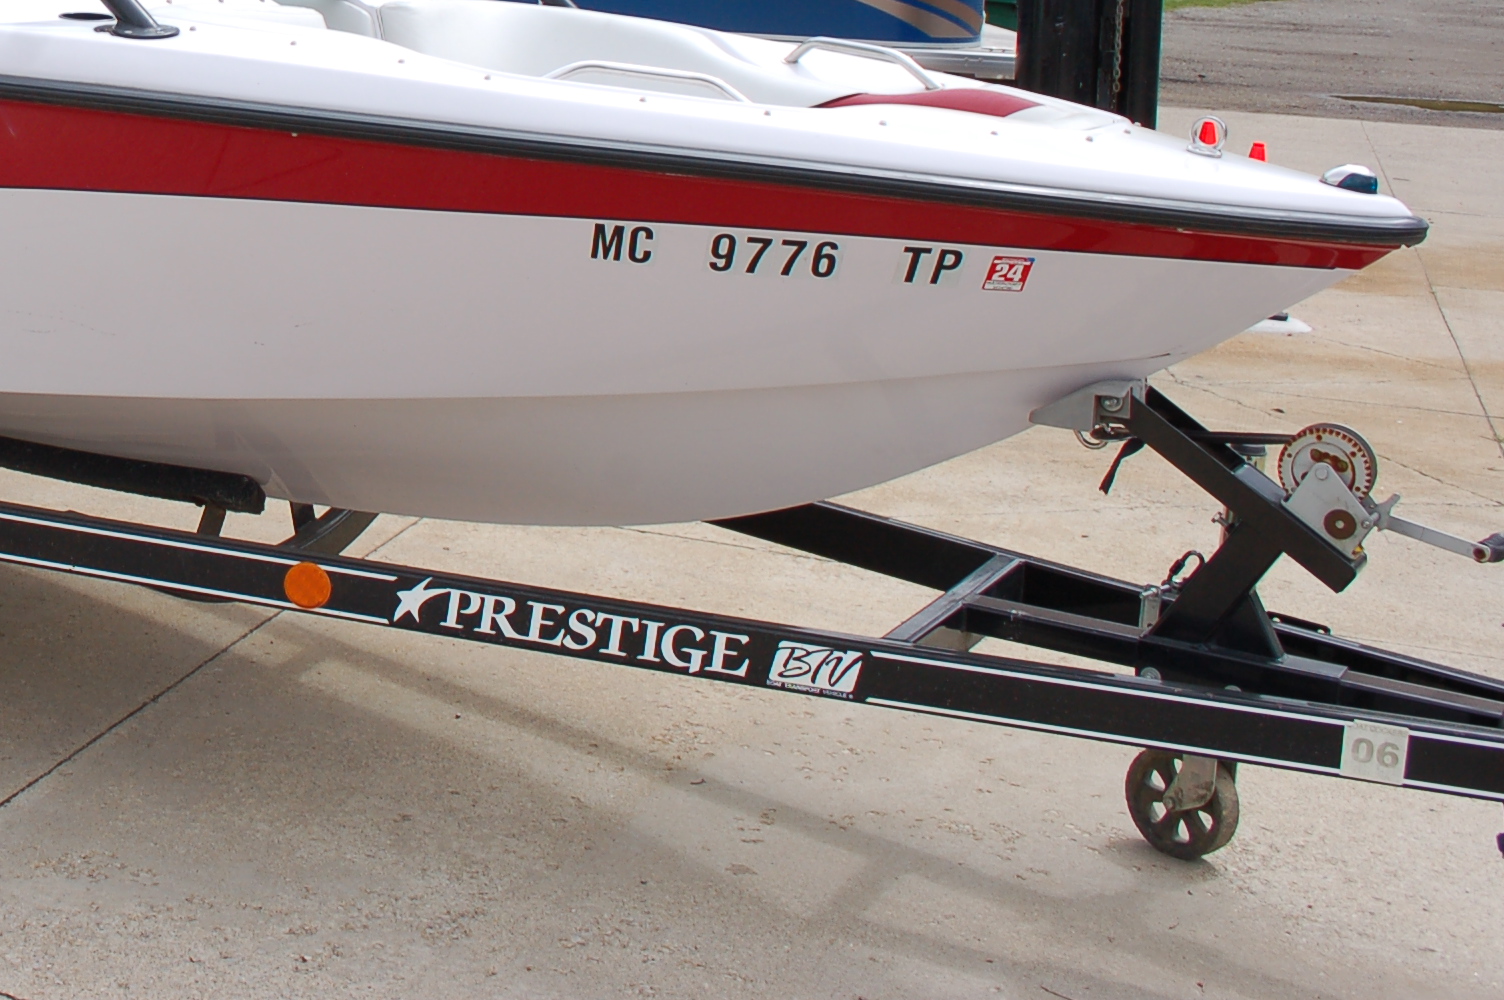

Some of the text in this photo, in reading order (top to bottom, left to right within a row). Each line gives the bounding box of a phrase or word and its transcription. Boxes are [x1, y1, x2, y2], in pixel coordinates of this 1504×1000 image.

[590, 223, 963, 285] MC 9776 TP
[991, 263, 1025, 282] 24
[440, 587, 750, 678] PRESTIGE
[1351, 737, 1400, 768] 06
